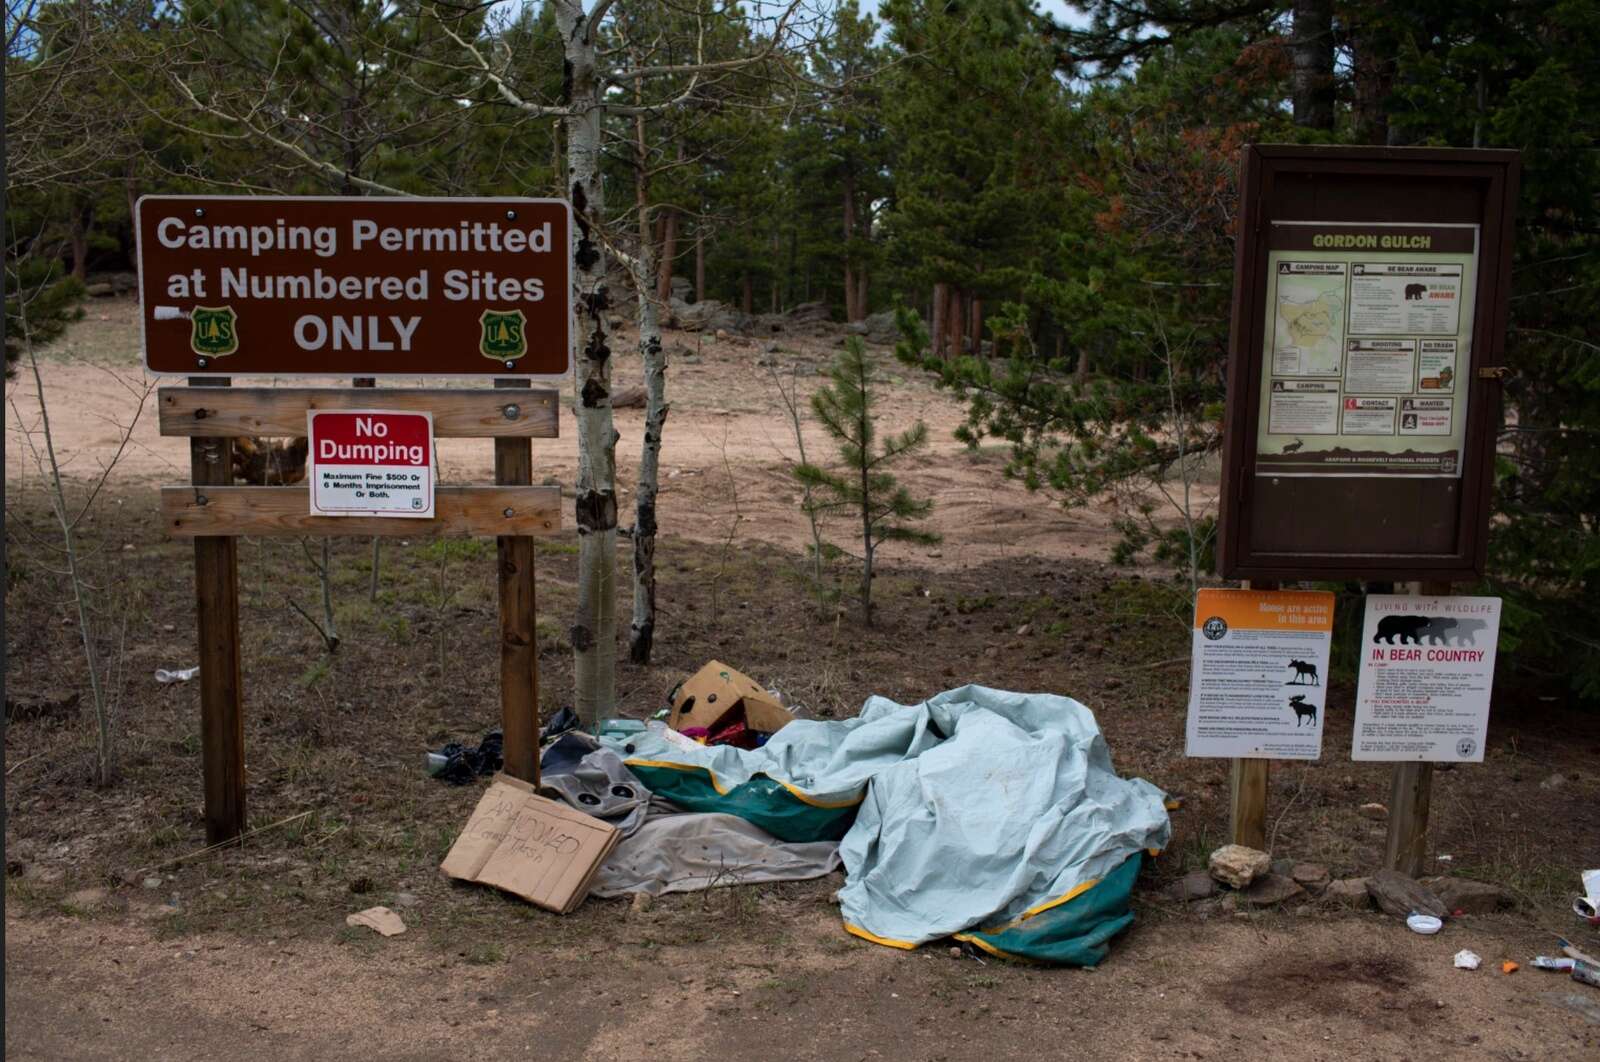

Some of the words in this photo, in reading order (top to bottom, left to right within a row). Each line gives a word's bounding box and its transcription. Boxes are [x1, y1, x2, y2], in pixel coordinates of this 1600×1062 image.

[156, 216, 338, 258] Camping
[352, 219, 553, 253] Permitted
[1312, 234, 1377, 248] GORDON
[1380, 235, 1431, 249] GULCH
[1295, 263, 1325, 271] CAMPING
[166, 269, 207, 299] at
[220, 267, 429, 301] Numbered
[443, 269, 545, 302] Sites
[293, 315, 422, 352] ONLY
[355, 417, 388, 438] No
[320, 439, 424, 465] Dumping
[323, 472, 362, 480] Maximum
[386, 473, 408, 481] $500
[366, 483, 420, 491] Imprisonment
[1374, 600, 1408, 612] LIVING
[1415, 602, 1438, 612] WITH
[1444, 603, 1493, 614] WILDLIFE
[1372, 648, 1385, 661] IN
[1390, 649, 1422, 661] BEAR
[1427, 649, 1485, 662] COUNTRY
